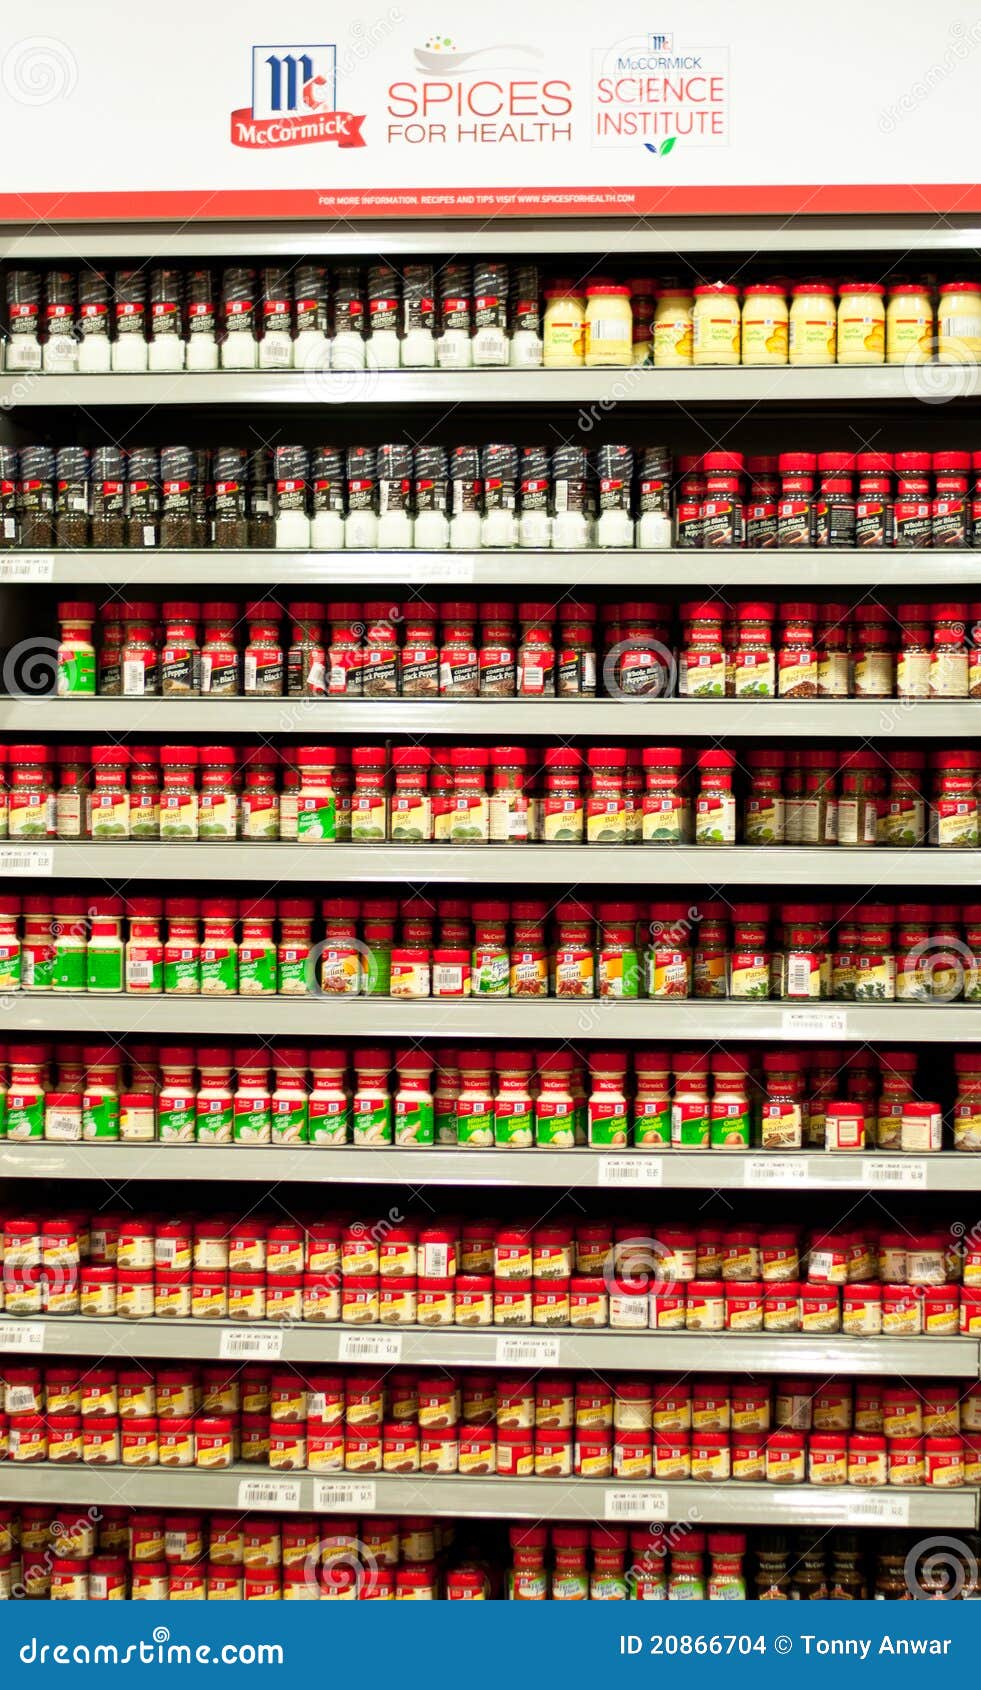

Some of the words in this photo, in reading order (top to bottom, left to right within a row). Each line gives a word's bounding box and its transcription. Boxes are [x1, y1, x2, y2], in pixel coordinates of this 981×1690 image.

[618, 57, 702, 70] McCORMICK
[387, 80, 573, 118] SPICES
[597, 77, 724, 103] SCIENCE
[235, 115, 350, 144] McCormick
[388, 124, 446, 143] FOR
[458, 123, 571, 142] HEALTH
[597, 111, 724, 135] INSTITUTE
[319, 196, 335, 205] FOR
[337, 196, 360, 205] MORE
[421, 195, 455, 205] RECIPES
[457, 195, 474, 204] AND
[477, 195, 494, 204] TIPS
[496, 195, 515, 204] VISIT
[375, 669, 395, 679] Pepper
